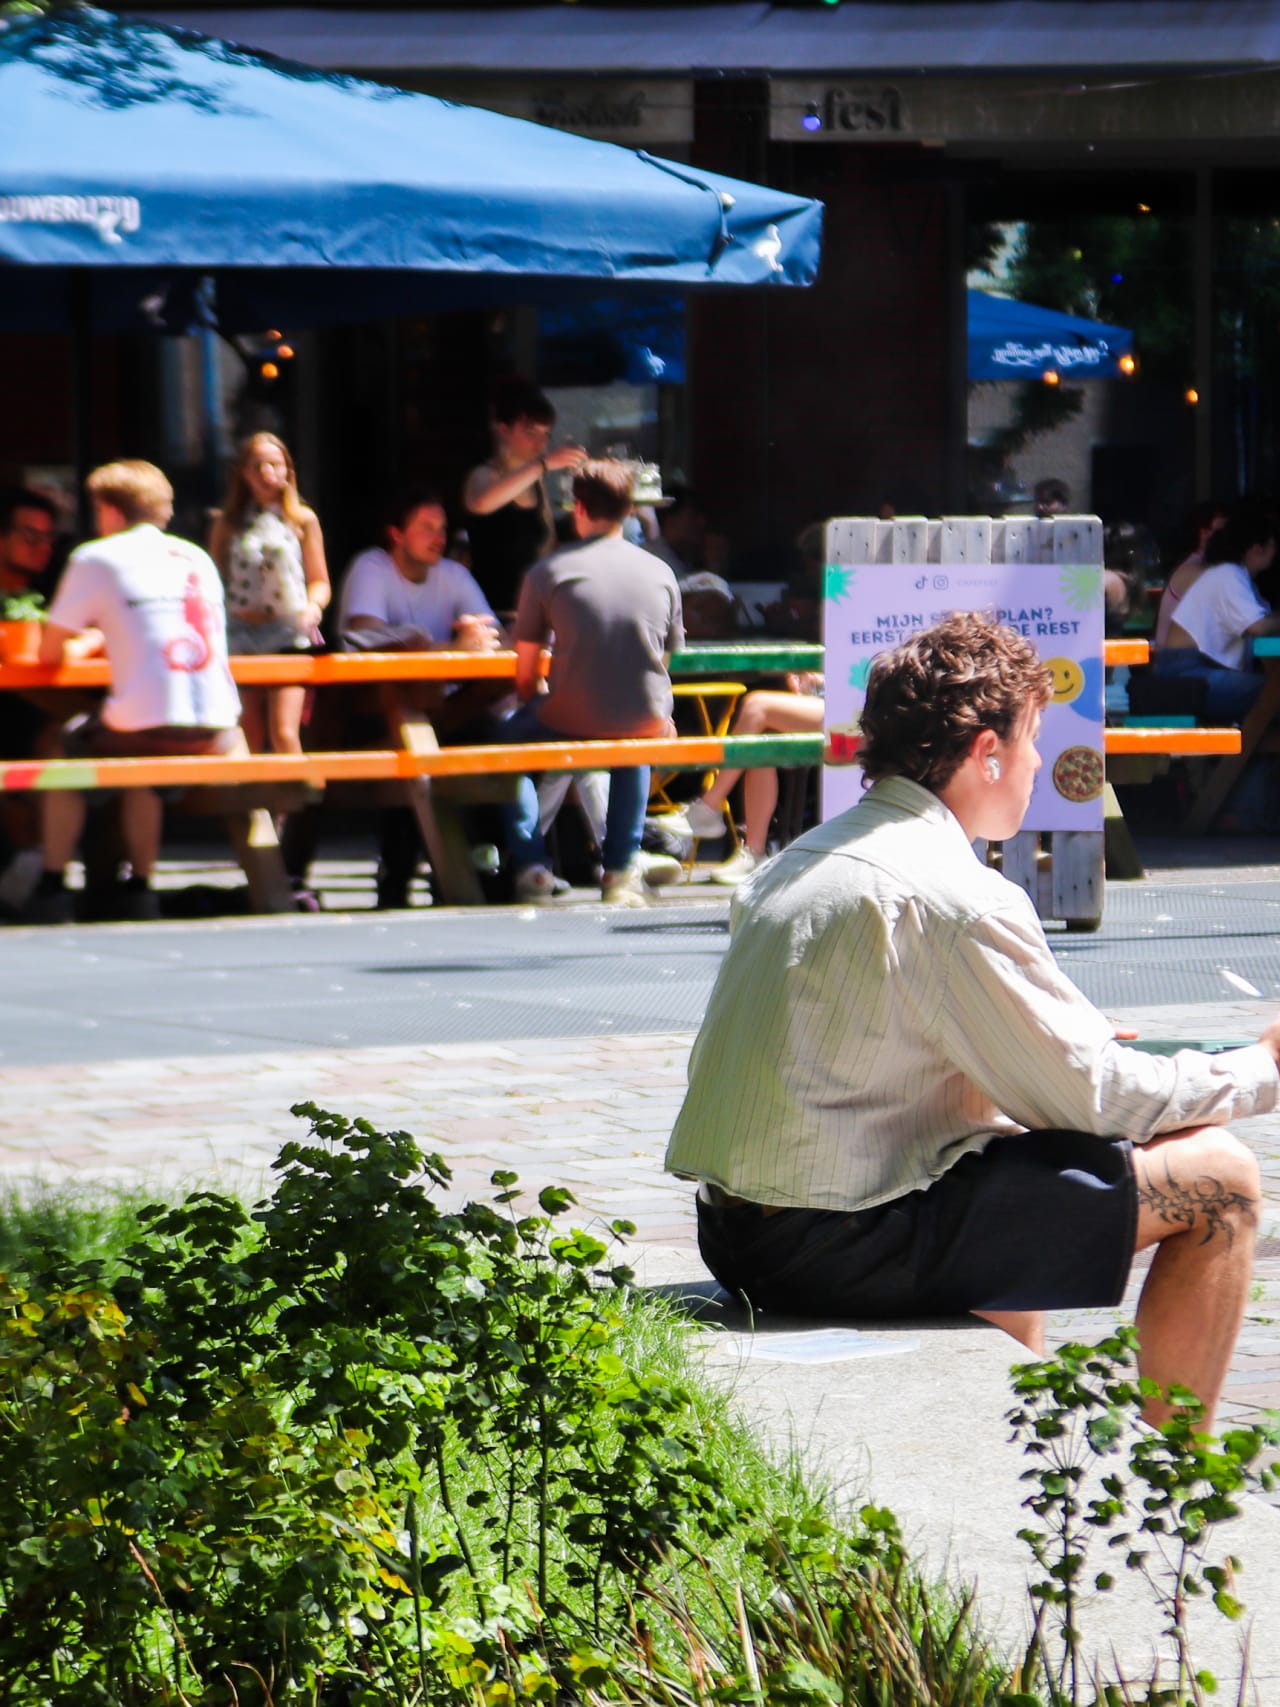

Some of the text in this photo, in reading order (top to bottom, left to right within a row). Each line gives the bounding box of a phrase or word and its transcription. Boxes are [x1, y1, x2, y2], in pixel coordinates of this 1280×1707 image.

[824, 87, 902, 131] fest
[876, 613, 924, 629] MIJN
[996, 607, 1054, 622] PLAN?
[851, 629, 905, 645] EERST
[1037, 621, 1080, 636] REST
